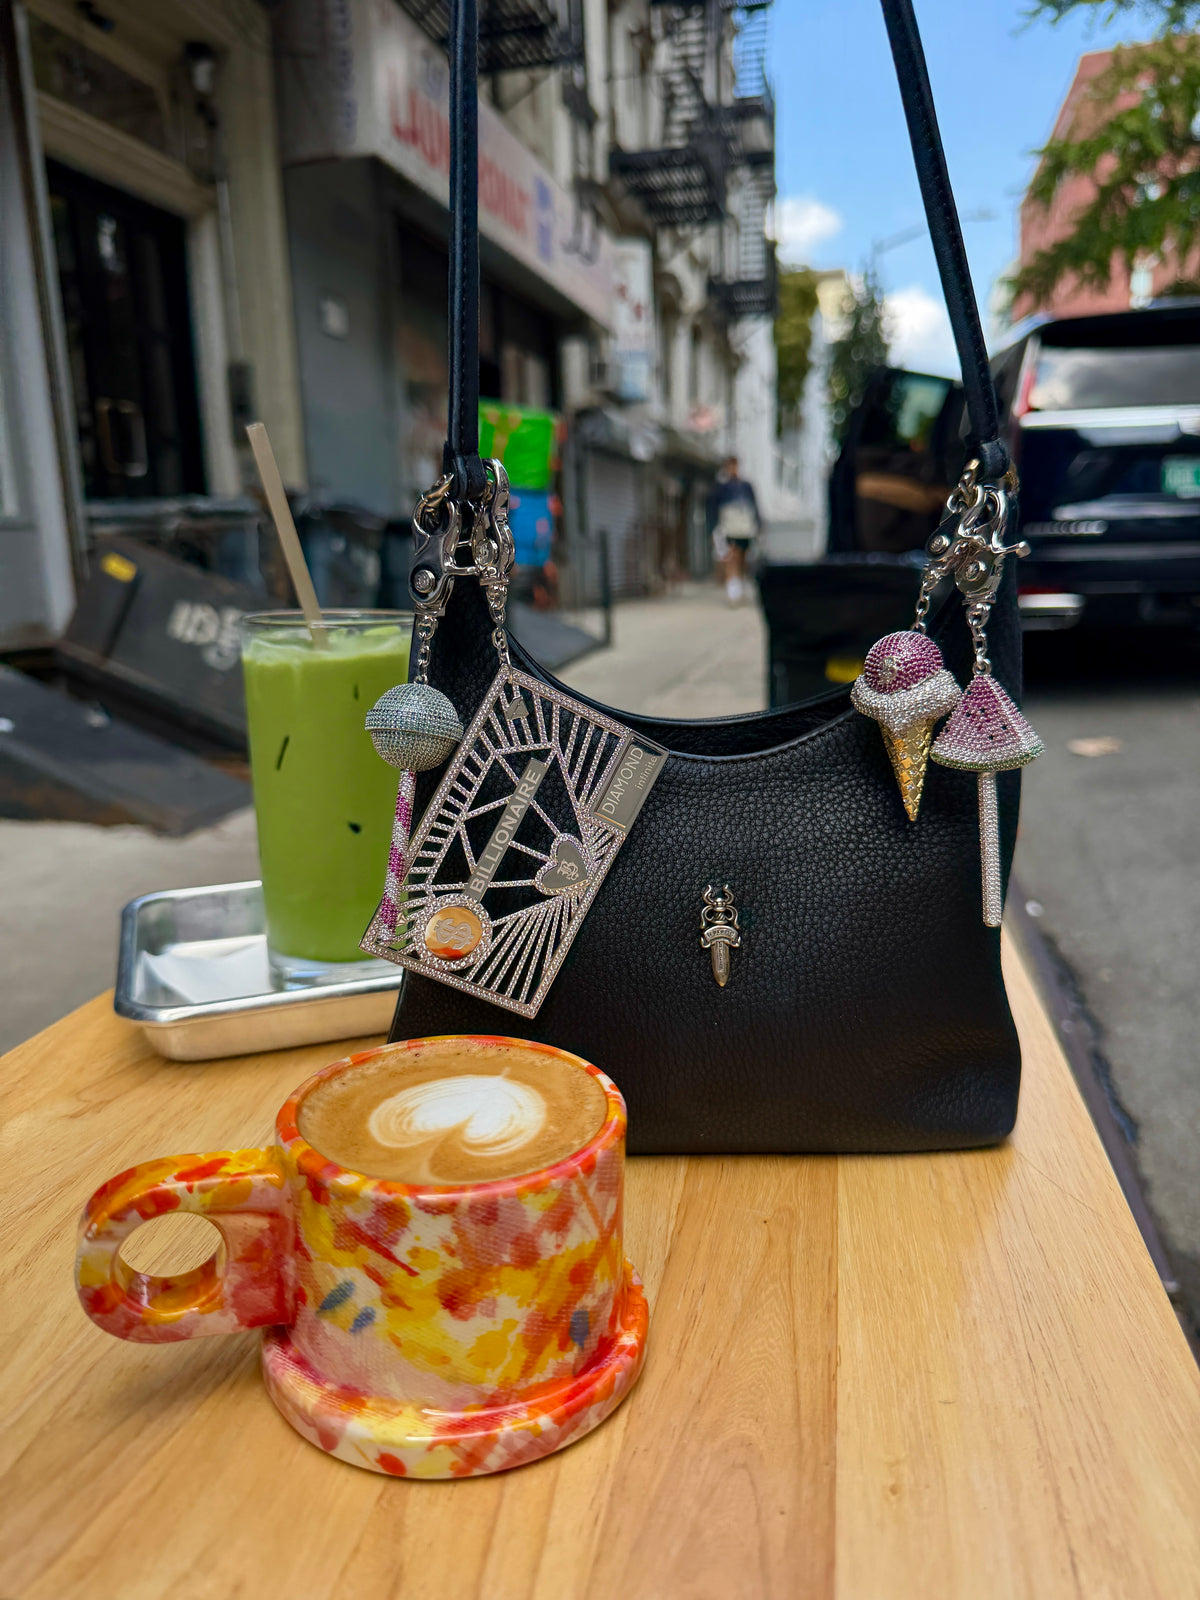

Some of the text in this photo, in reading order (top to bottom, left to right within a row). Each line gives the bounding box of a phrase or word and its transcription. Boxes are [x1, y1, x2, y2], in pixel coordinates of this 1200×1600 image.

[601, 747, 644, 815] DIAMOND
[634, 756, 658, 790] infinite
[469, 769, 541, 893] BILLIONAIRE
